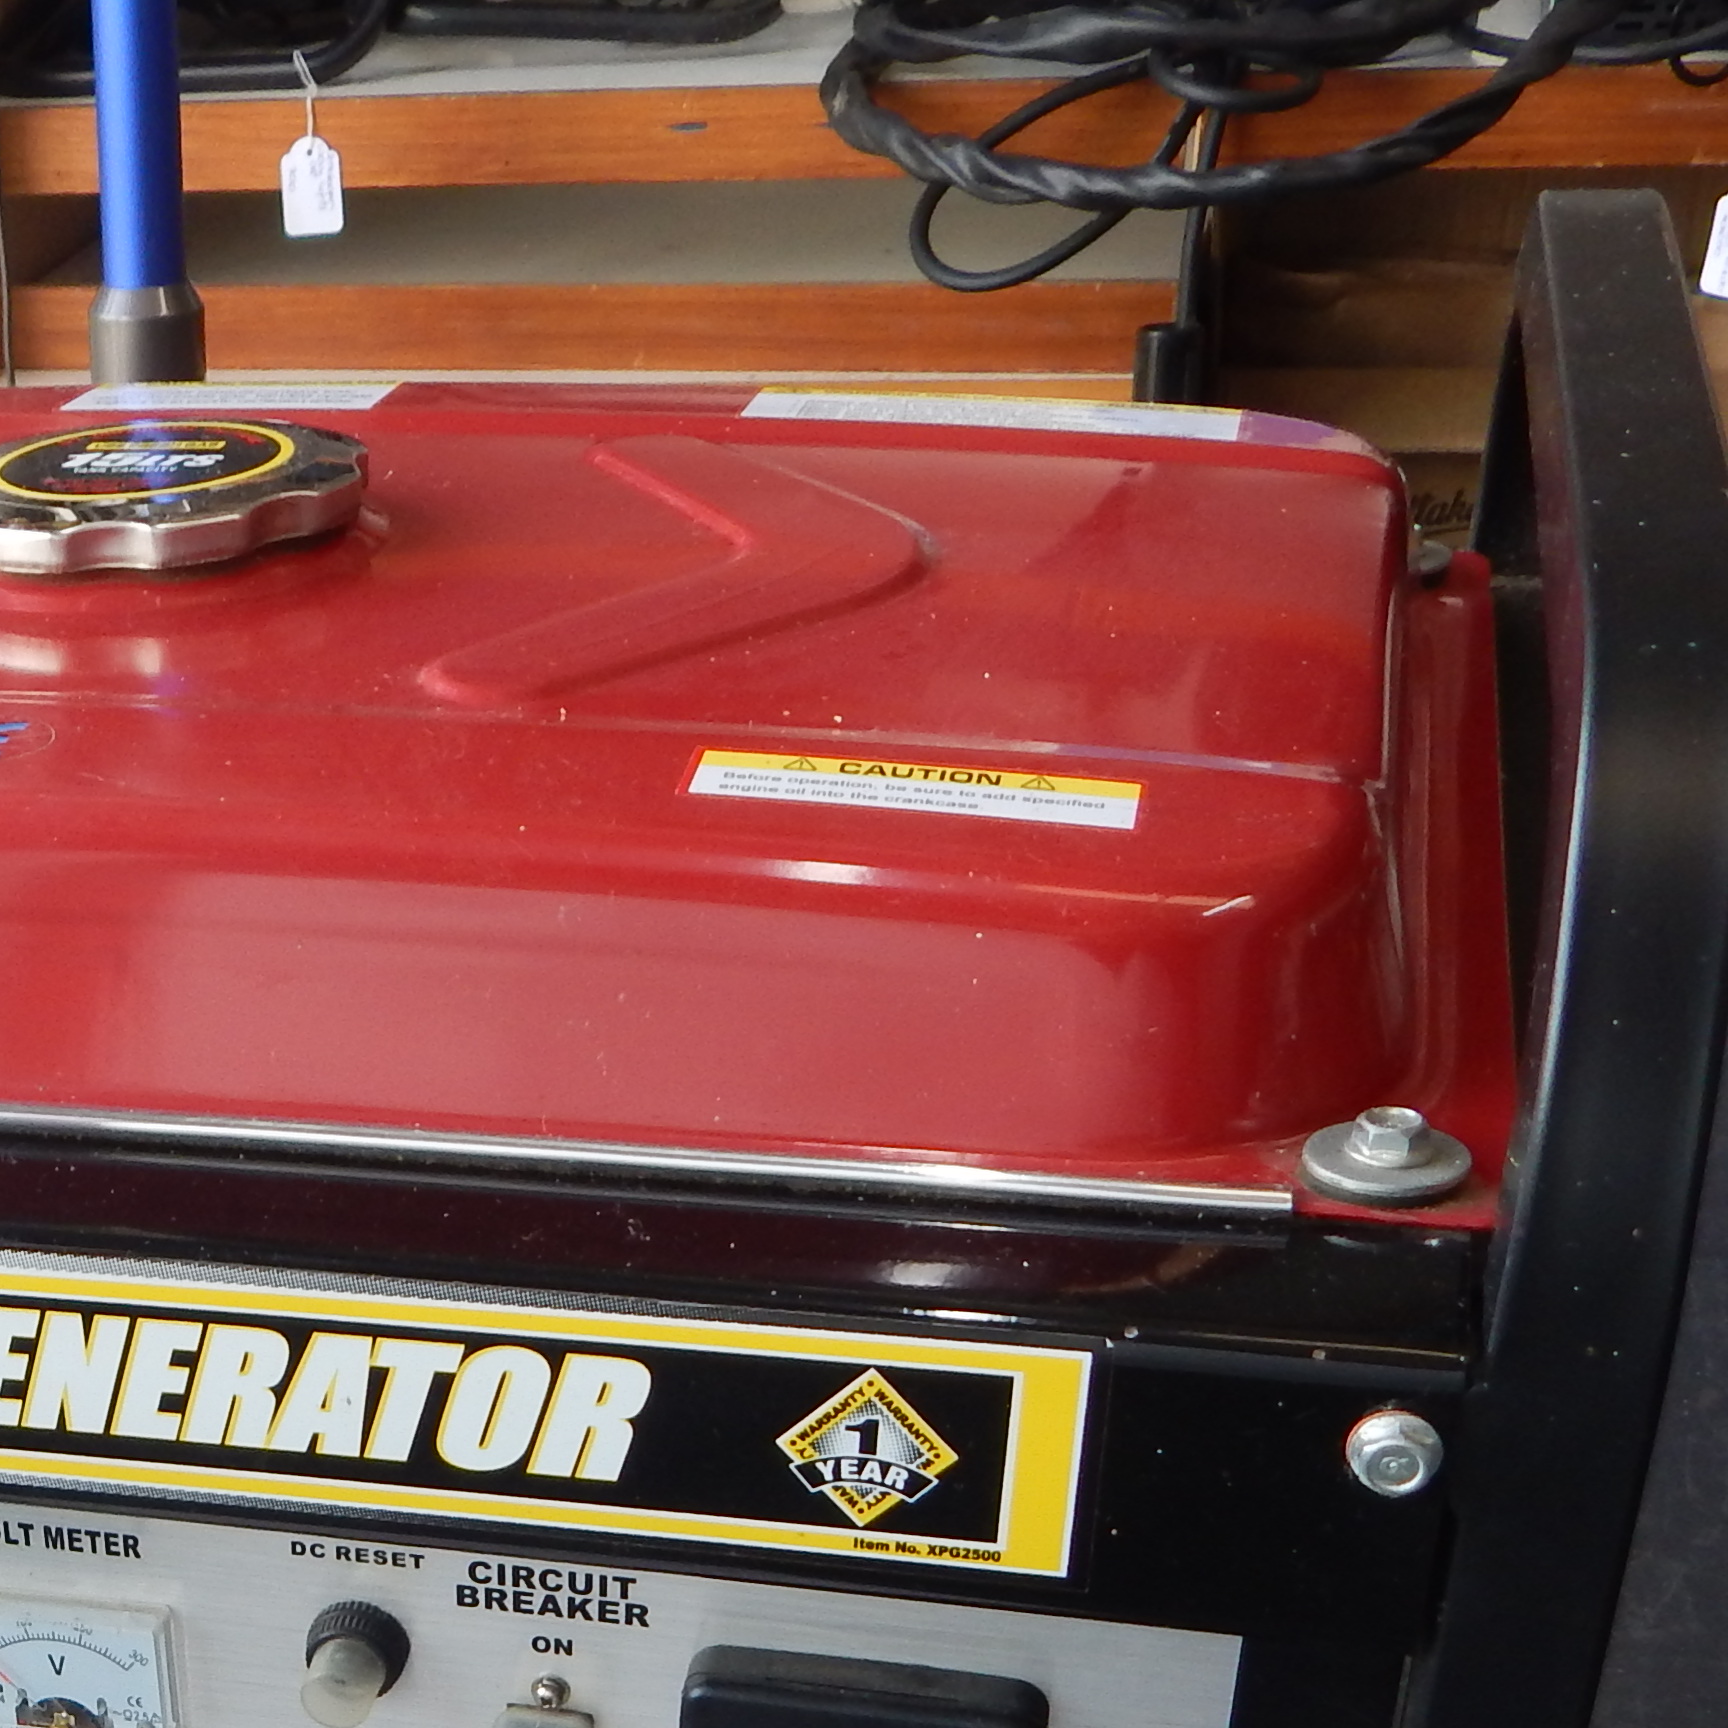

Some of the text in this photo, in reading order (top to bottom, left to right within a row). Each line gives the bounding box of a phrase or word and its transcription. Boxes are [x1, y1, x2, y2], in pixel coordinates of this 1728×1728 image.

[838, 761, 1003, 786] CAUTION
[718, 783, 779, 794] engine
[785, 787, 806, 796] oil
[811, 789, 845, 798] into
[850, 792, 879, 801] the
[723, 771, 782, 783] Before
[884, 783, 907, 793] be
[913, 786, 953, 797] sure
[959, 789, 976, 798] to
[982, 792, 1016, 802] add
[1022, 796, 1106, 810] specified
[795, 1387, 866, 1442] WARRANTY
[873, 1387, 939, 1453] WARRANTY
[845, 1418, 880, 1455] 1
[815, 1458, 909, 1490] YEAR
[43, 1525, 142, 1559] METER
[290, 1540, 425, 1570] DC RESET
[853, 1537, 1001, 1563] Item No. XPG2500
[468, 1560, 637, 1600] CIRCUIT
[455, 1584, 651, 1628] BREAKER
[128, 1649, 150, 1667] 300
[531, 1635, 575, 1656] ON
[47, 1653, 65, 1676] V
